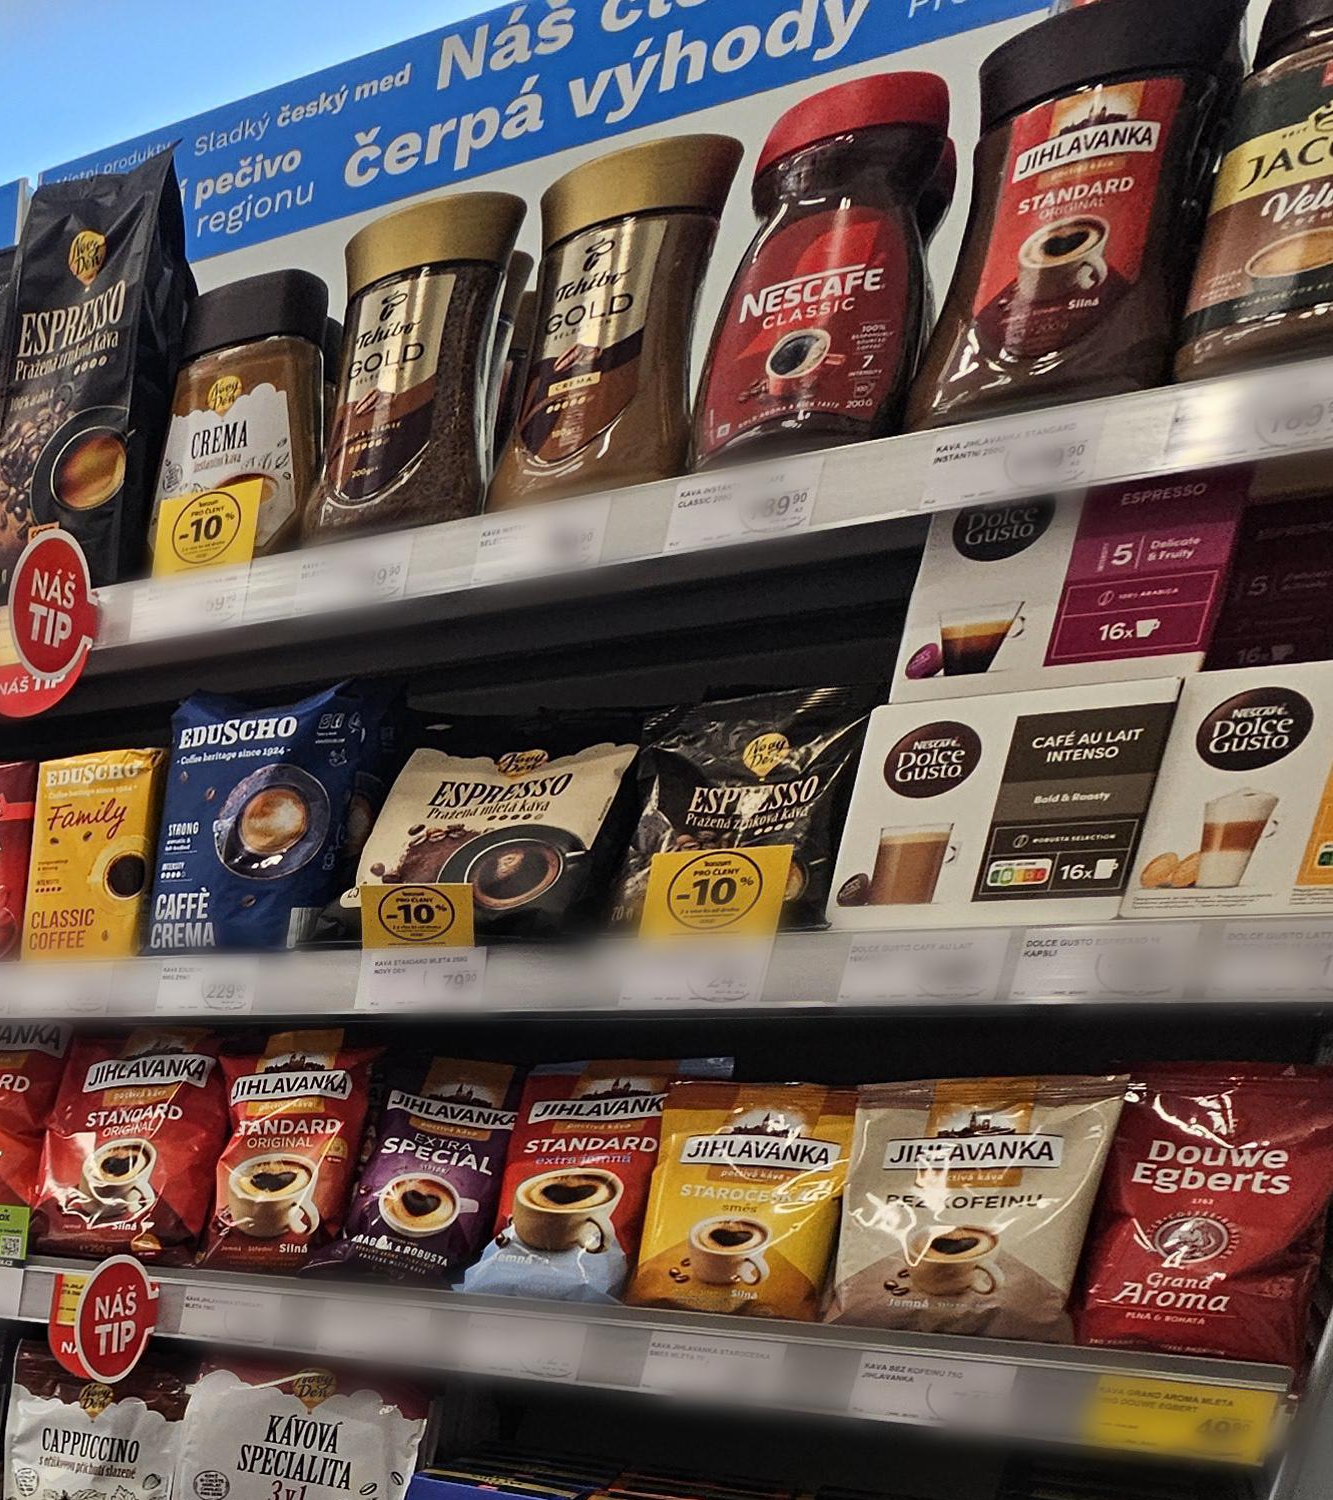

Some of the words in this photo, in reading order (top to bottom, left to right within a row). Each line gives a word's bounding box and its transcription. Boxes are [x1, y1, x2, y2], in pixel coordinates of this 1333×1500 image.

[436, 0, 575, 91] Náš
[343, 76, 544, 189] čerpá
[568, 0, 868, 124] výhody
[193, 112, 270, 157] Sladký
[276, 89, 349, 131] český
[353, 65, 412, 103] med
[1020, 127, 1154, 175] JIHLAVANKA
[195, 149, 301, 205] pečivo
[196, 183, 315, 238] regionu
[1017, 177, 1134, 216] STANDARD
[1038, 198, 1105, 220] ORIGINAL
[18, 280, 127, 357] ESPRESSO
[545, 294, 633, 336] GOLD
[763, 298, 856, 329] CLASSIC
[1068, 296, 1099, 310] Silná
[348, 342, 424, 383] GOLD
[192, 420, 247, 458] CREMA
[1150, 536, 1201, 550] Delicate
[178, 716, 298, 750] EDUSCHO
[1032, 731, 1076, 750] CAFÉ
[1078, 732, 1101, 745] AU
[1106, 728, 1144, 743] LAIT
[1209, 733, 1290, 753] Gusto
[1212, 717, 1294, 739] Dolce
[1046, 746, 1120, 763] INTENSO
[894, 762, 962, 783] Gusto
[428, 771, 572, 811] ESPRESSO
[48, 798, 127, 840] Family
[427, 803, 478, 822] Pražená
[480, 800, 514, 816] mletá
[517, 796, 550, 813] káva
[168, 821, 199, 837] STRONG
[1060, 865, 1093, 880] 16x
[31, 908, 95, 929] CLASSIC
[29, 929, 85, 950] COFFEE
[389, 1093, 517, 1126] JIHLAVANKA
[246, 1136, 313, 1149] ORIGINAL
[380, 1137, 492, 1175] SPECIAL
[414, 1134, 473, 1152] EXTRA
[523, 1137, 657, 1153] STANDARD
[688, 1138, 830, 1165] JIHLAVANKA
[890, 1138, 1054, 1164] JIHLAVANKA
[1149, 1138, 1289, 1169] Douwe
[1132, 1163, 1291, 1196] Egberts
[1111, 1280, 1230, 1312] Aroma
[1146, 1272, 1213, 1290] Grand
[41, 1428, 140, 1464] CAPPUCCINO
[265, 1413, 339, 1454] KÁVOVÁ
[236, 1443, 351, 1489] SPECIALITA
